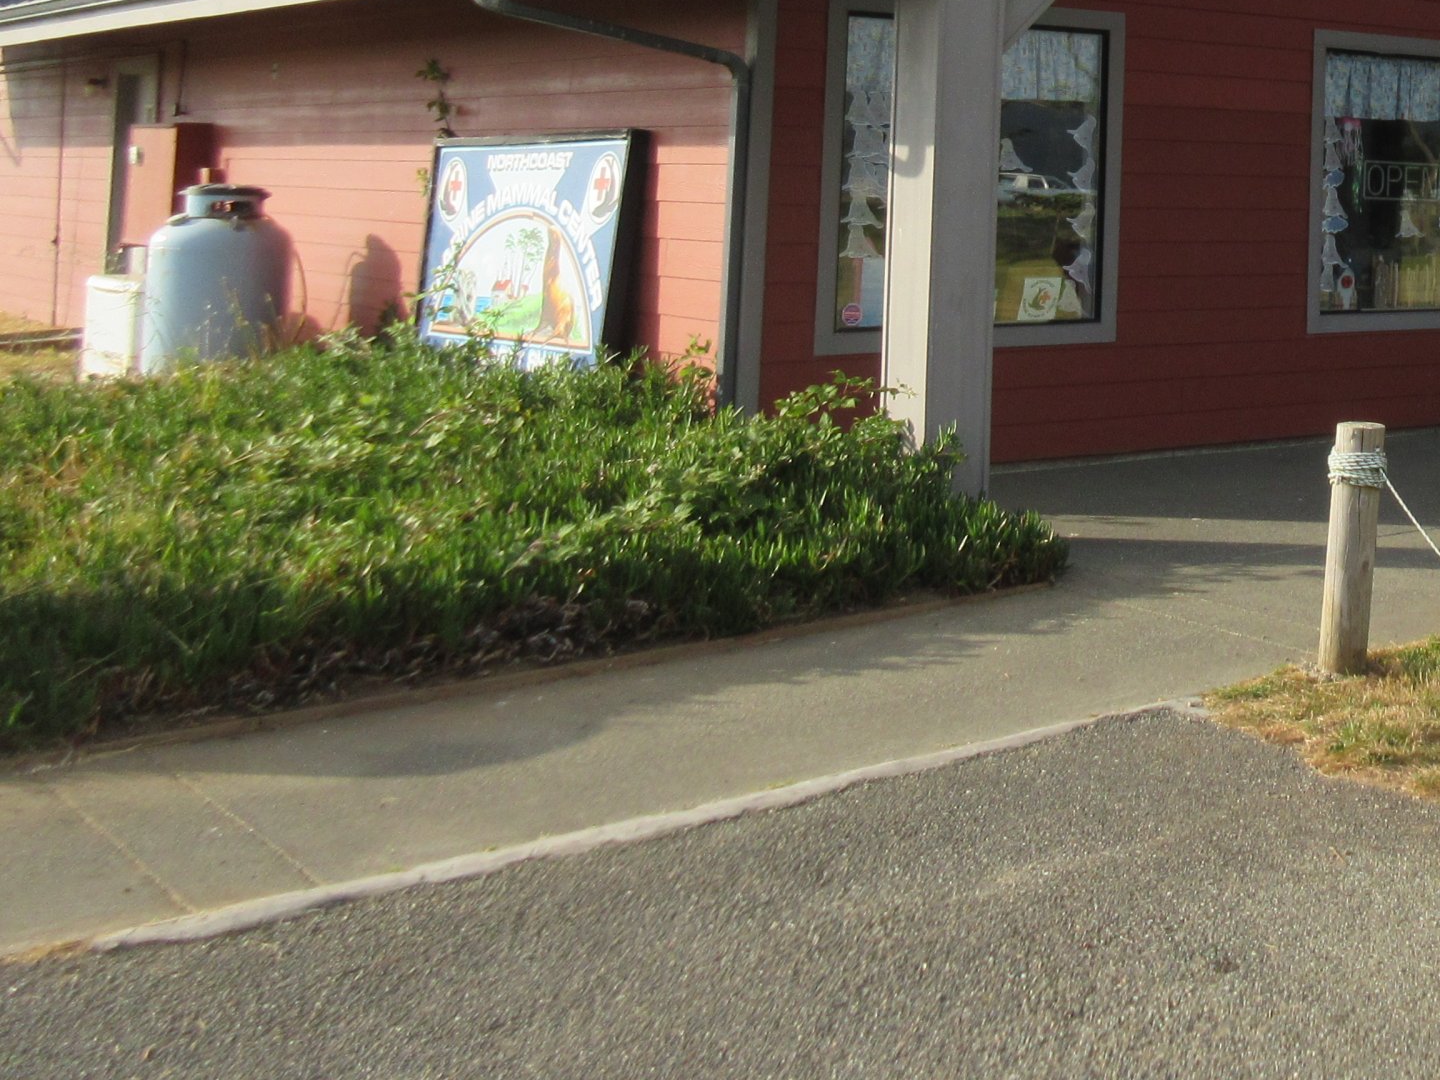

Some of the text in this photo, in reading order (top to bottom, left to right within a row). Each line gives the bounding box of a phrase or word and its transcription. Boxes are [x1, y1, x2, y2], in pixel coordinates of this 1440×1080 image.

[1367, 164, 1439, 198] OPEN
[485, 182, 559, 216] MAMMAL
[558, 199, 603, 312] CENTER
